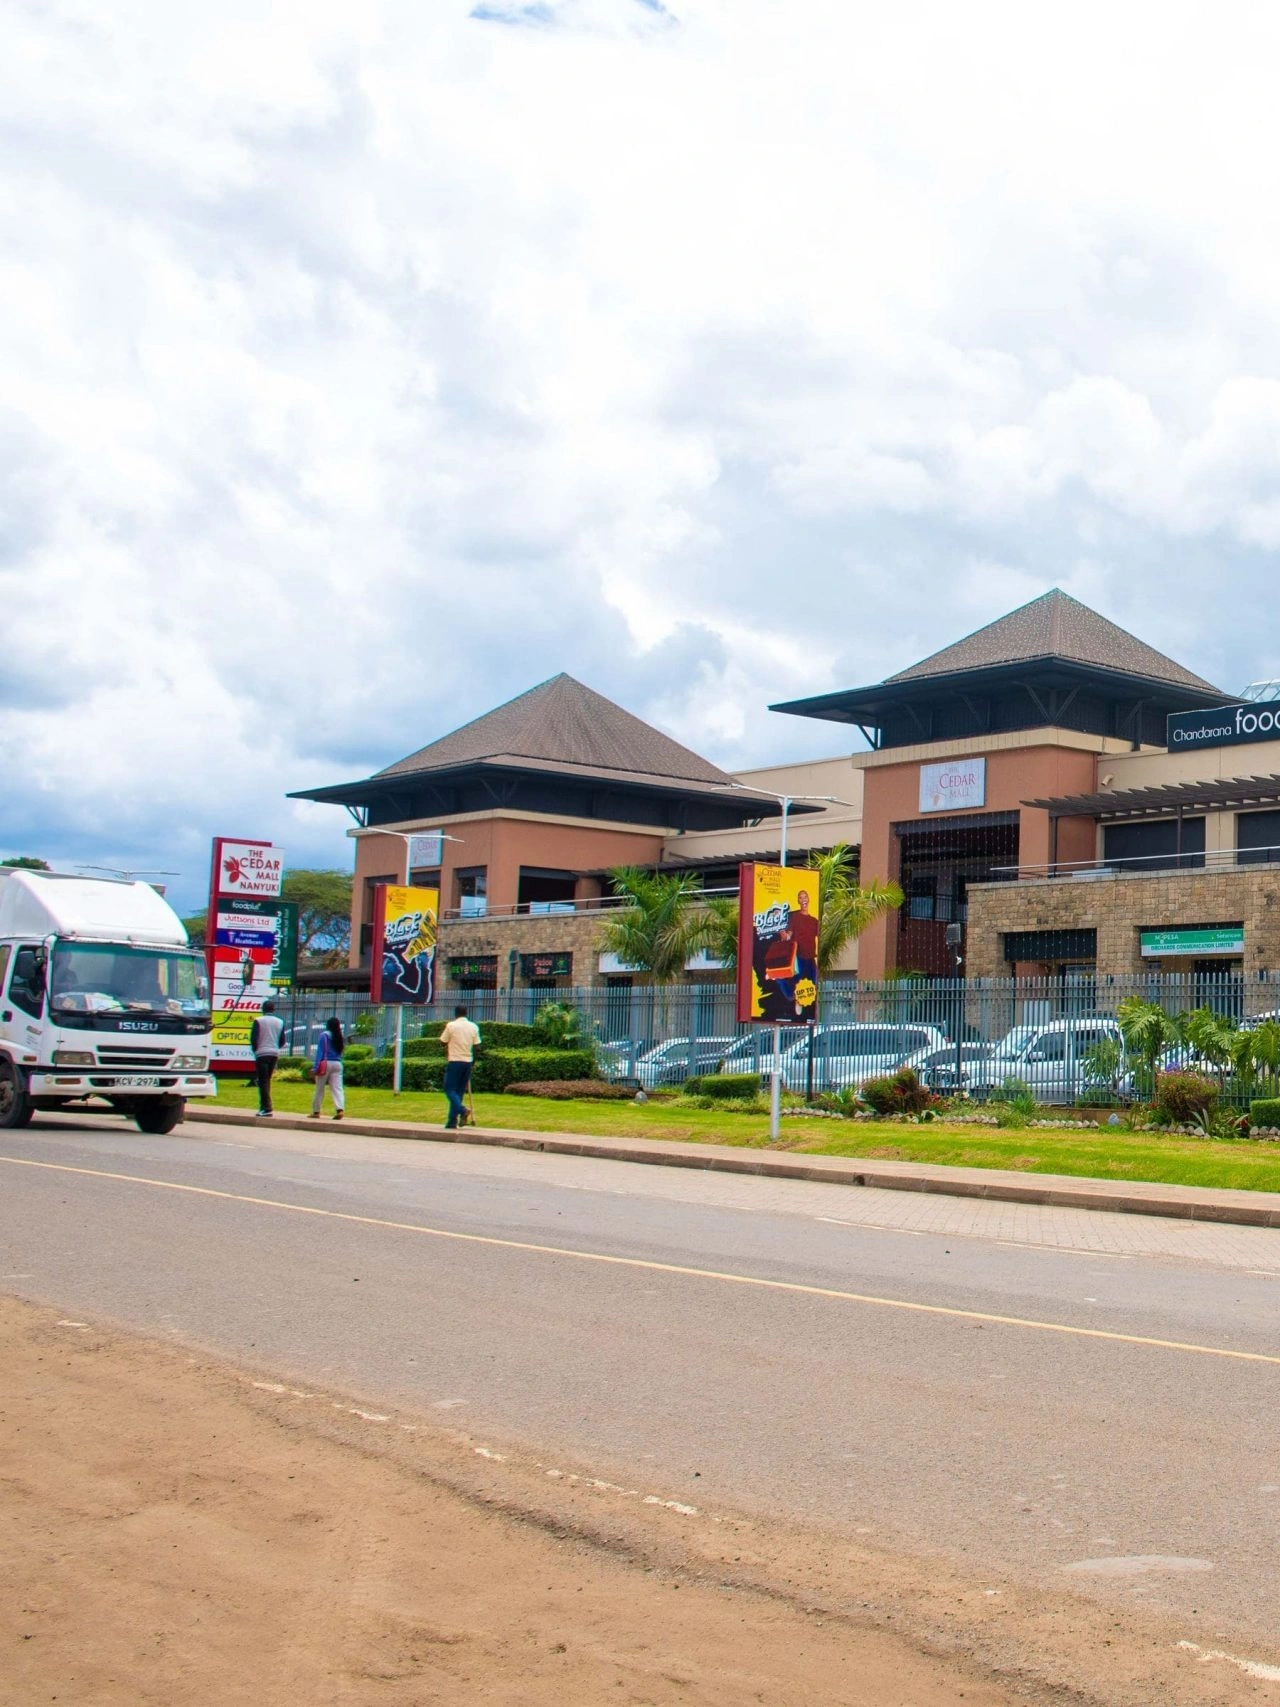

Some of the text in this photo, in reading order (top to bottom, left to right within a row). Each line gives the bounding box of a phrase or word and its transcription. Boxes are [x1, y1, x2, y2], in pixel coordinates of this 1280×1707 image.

[1173, 726, 1232, 742] Chandarana
[940, 773, 976, 789] CEDAR
[248, 849, 264, 858] THE
[239, 857, 280, 870] CEDAR
[256, 871, 279, 880] MALL
[240, 881, 279, 892] NANYUKI
[224, 914, 255, 924] Juttsons
[257, 917, 270, 926] Ltd
[752, 902, 790, 928] Black
[385, 912, 422, 937] Black
[796, 988, 804, 996] UP
[221, 999, 261, 1010] Bata
[119, 1022, 158, 1032] ISUZU
[115, 1077, 160, 1087] KCV 297A
